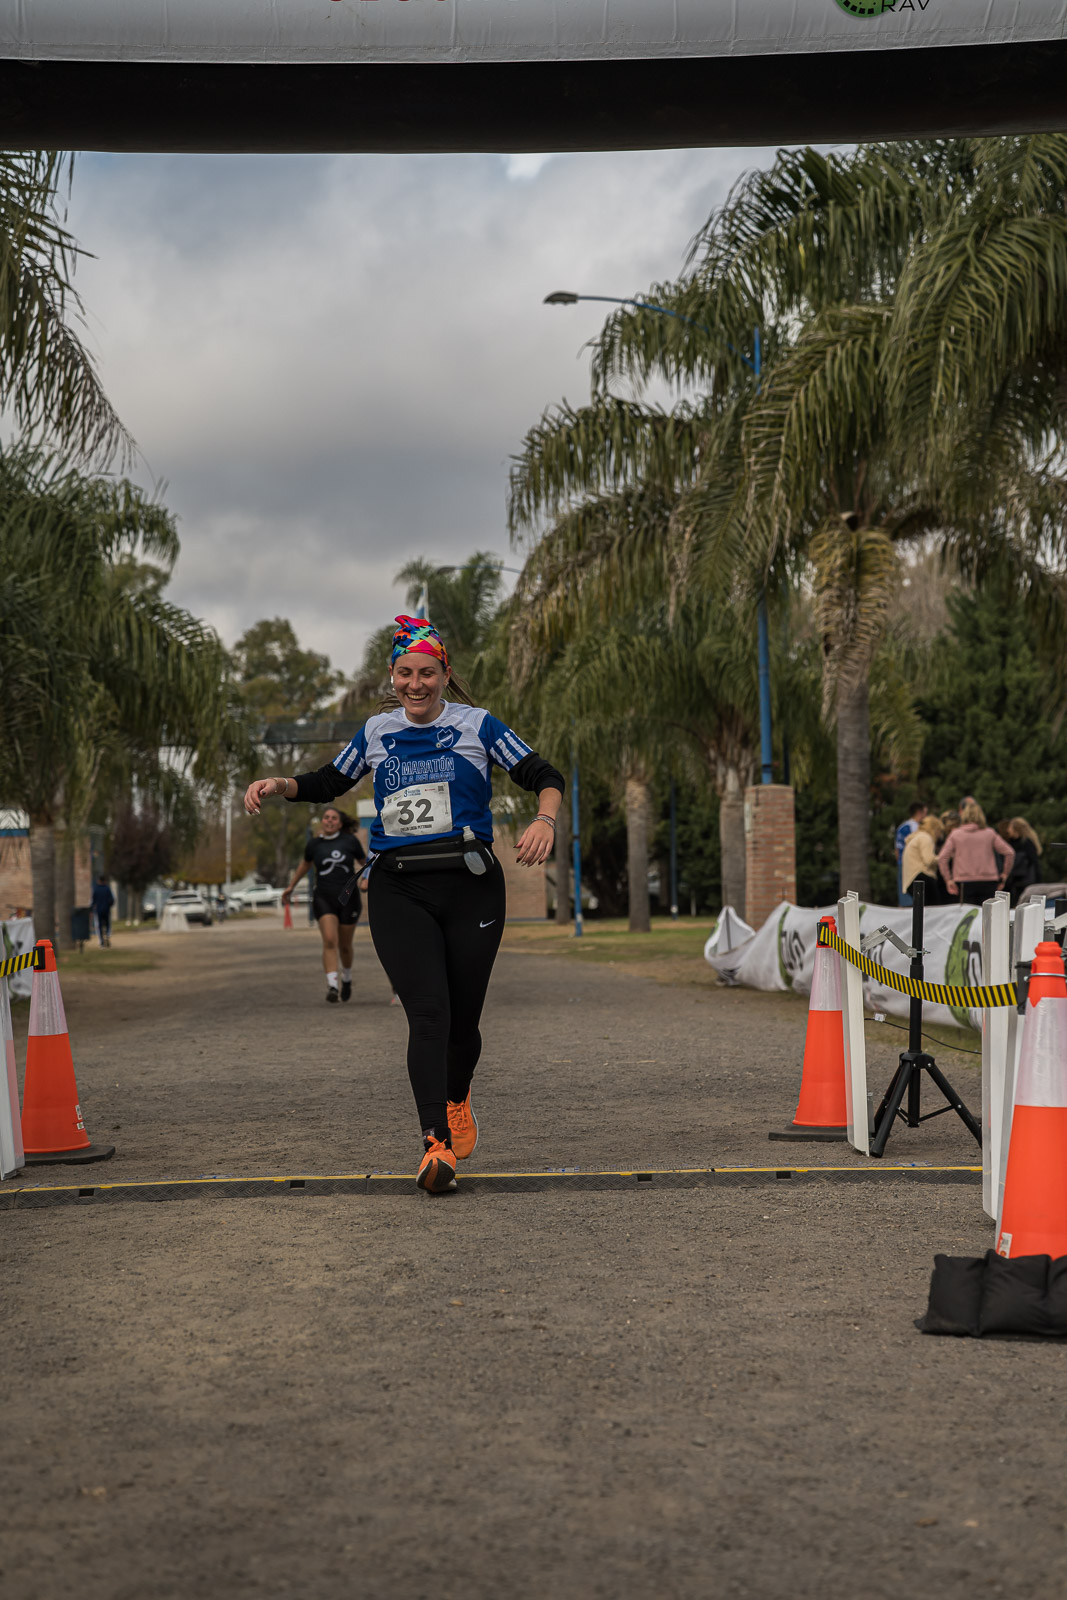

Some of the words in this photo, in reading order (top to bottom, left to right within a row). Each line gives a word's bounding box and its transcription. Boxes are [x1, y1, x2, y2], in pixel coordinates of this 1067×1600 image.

[385, 756, 400, 790] 3
[402, 755, 455, 775] MARATÓN
[397, 799, 434, 825] 32
